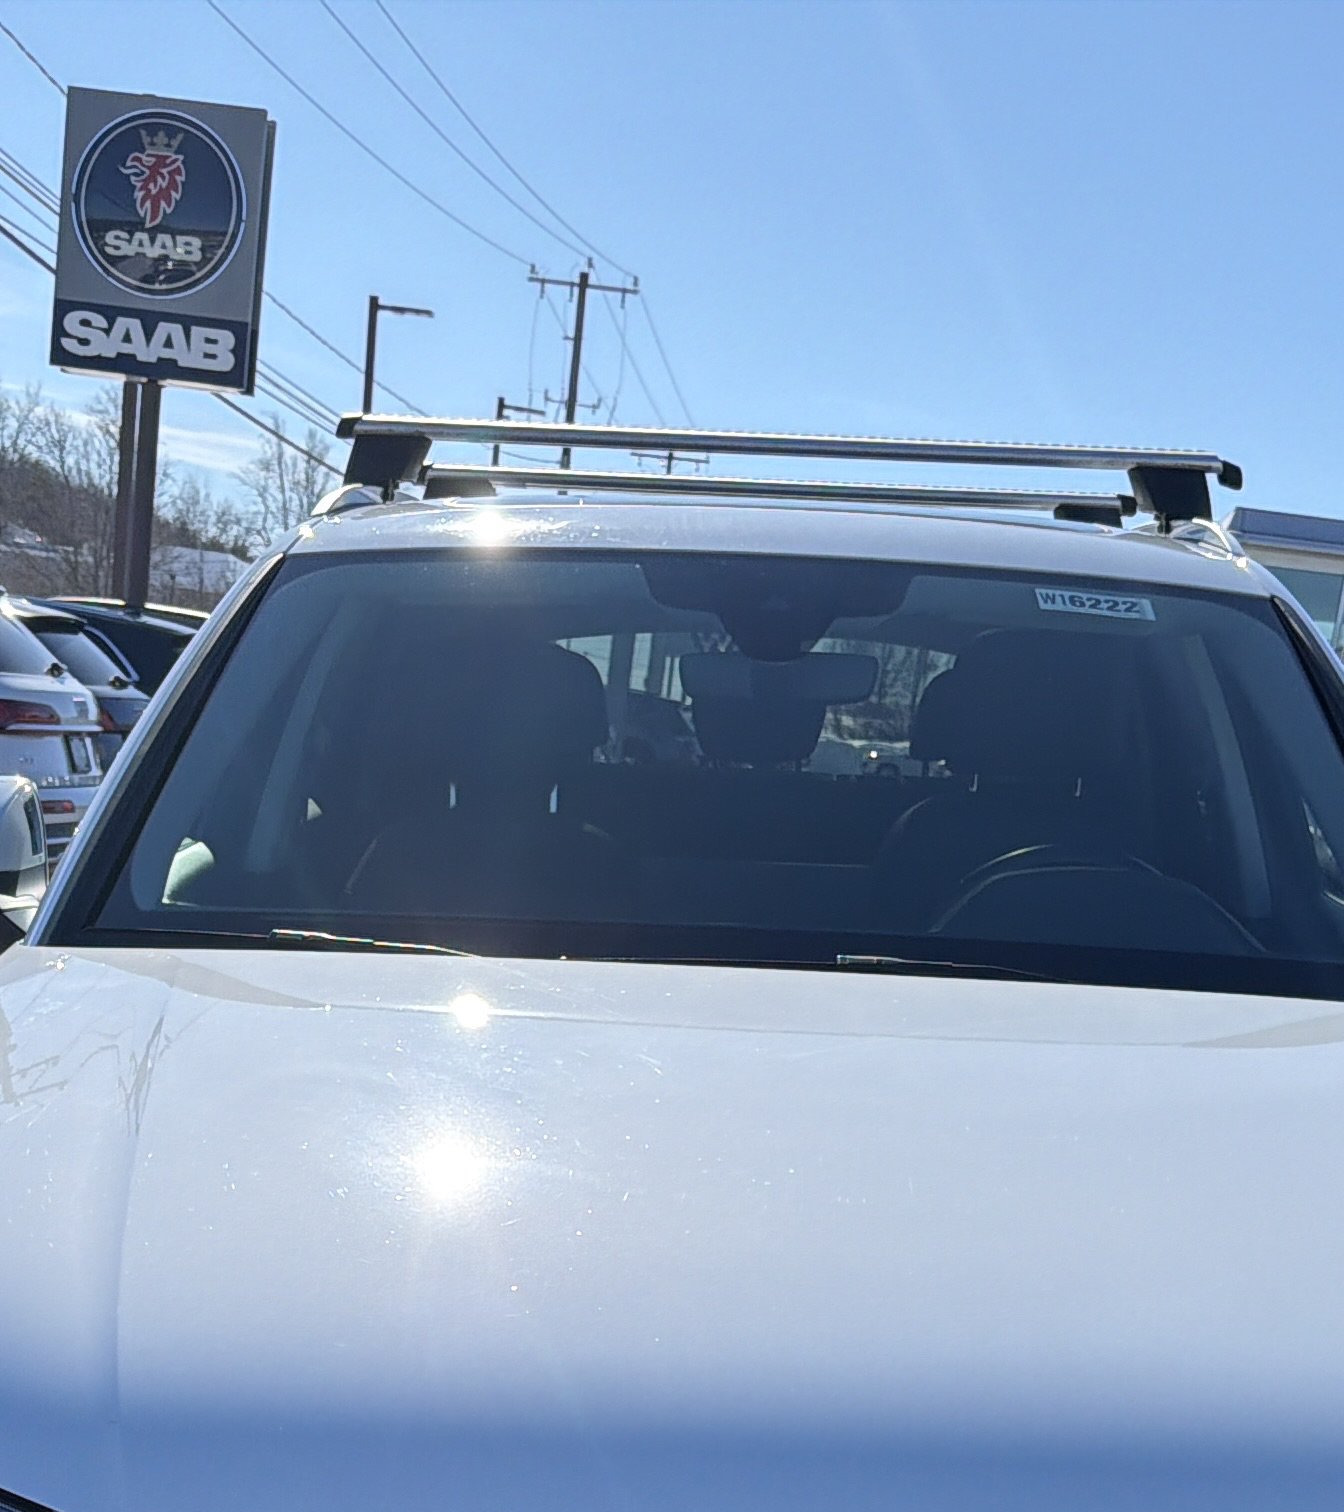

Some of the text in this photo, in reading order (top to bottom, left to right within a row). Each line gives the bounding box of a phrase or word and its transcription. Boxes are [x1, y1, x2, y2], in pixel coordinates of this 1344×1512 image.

[104, 229, 202, 262] SAAB
[60, 310, 236, 372] SAAB
[1039, 591, 1141, 613] W16222
